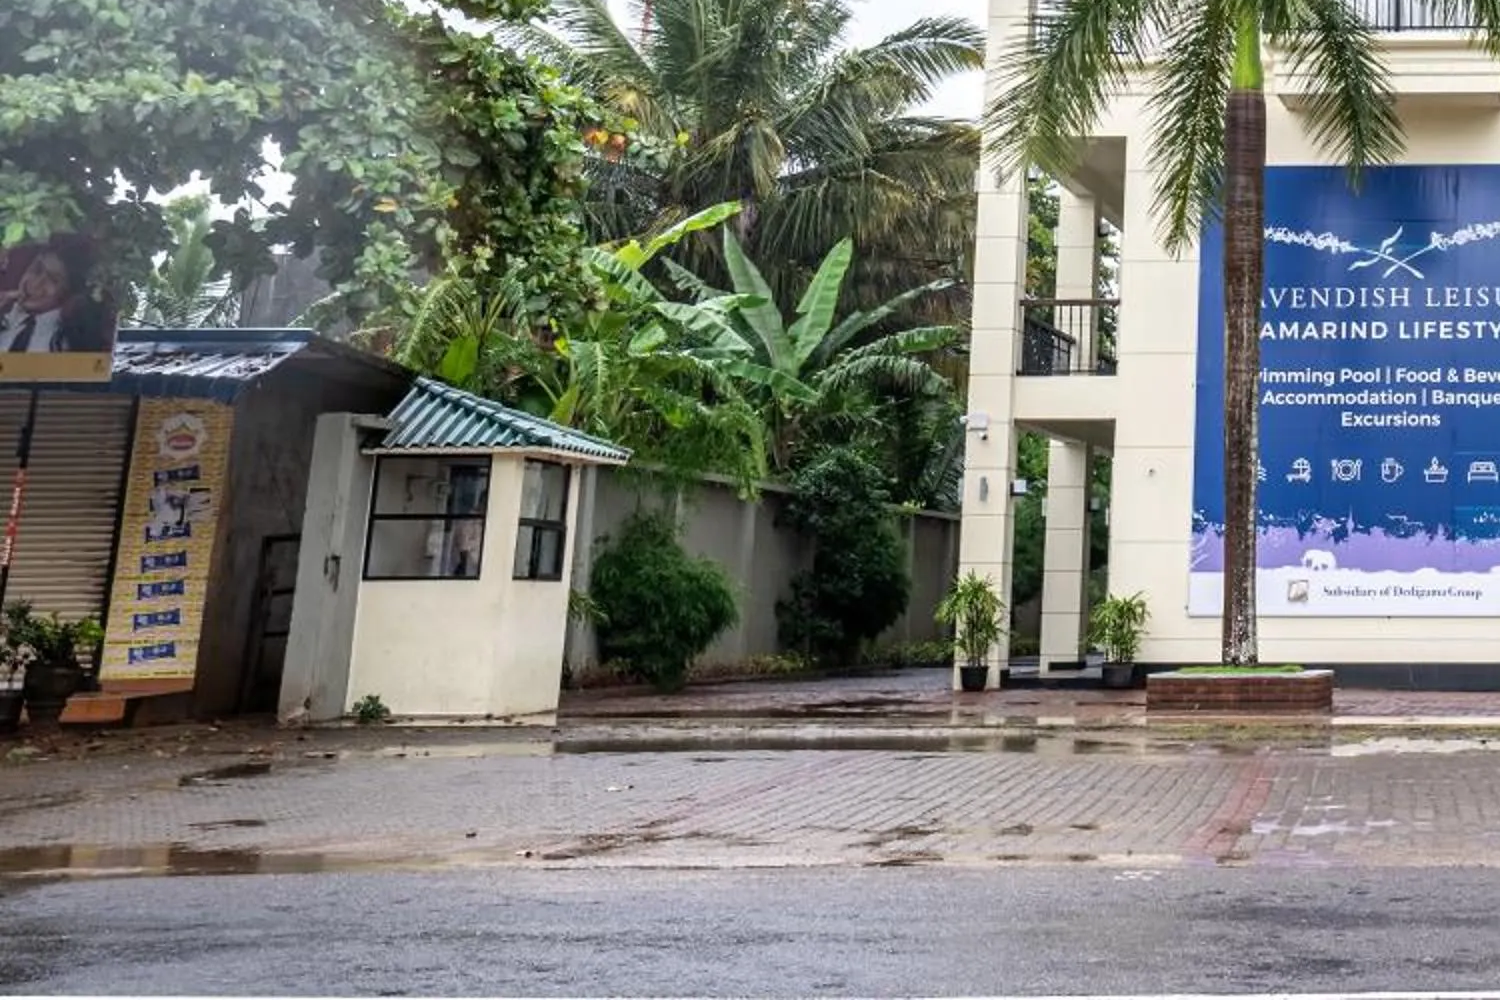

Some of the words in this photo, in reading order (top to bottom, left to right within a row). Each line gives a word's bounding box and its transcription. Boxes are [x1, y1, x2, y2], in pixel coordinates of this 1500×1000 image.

[1261, 286, 1410, 309] VENDISH
[1259, 320, 1389, 340] AMARIND
[1260, 367, 1335, 387] imming
[1340, 367, 1381, 383] Pool
[1395, 367, 1442, 383] Food
[1447, 367, 1459, 383] &
[1261, 388, 1417, 405] Accommodation
[1341, 410, 1441, 427] Excursions
[1379, 585, 1392, 597] of
